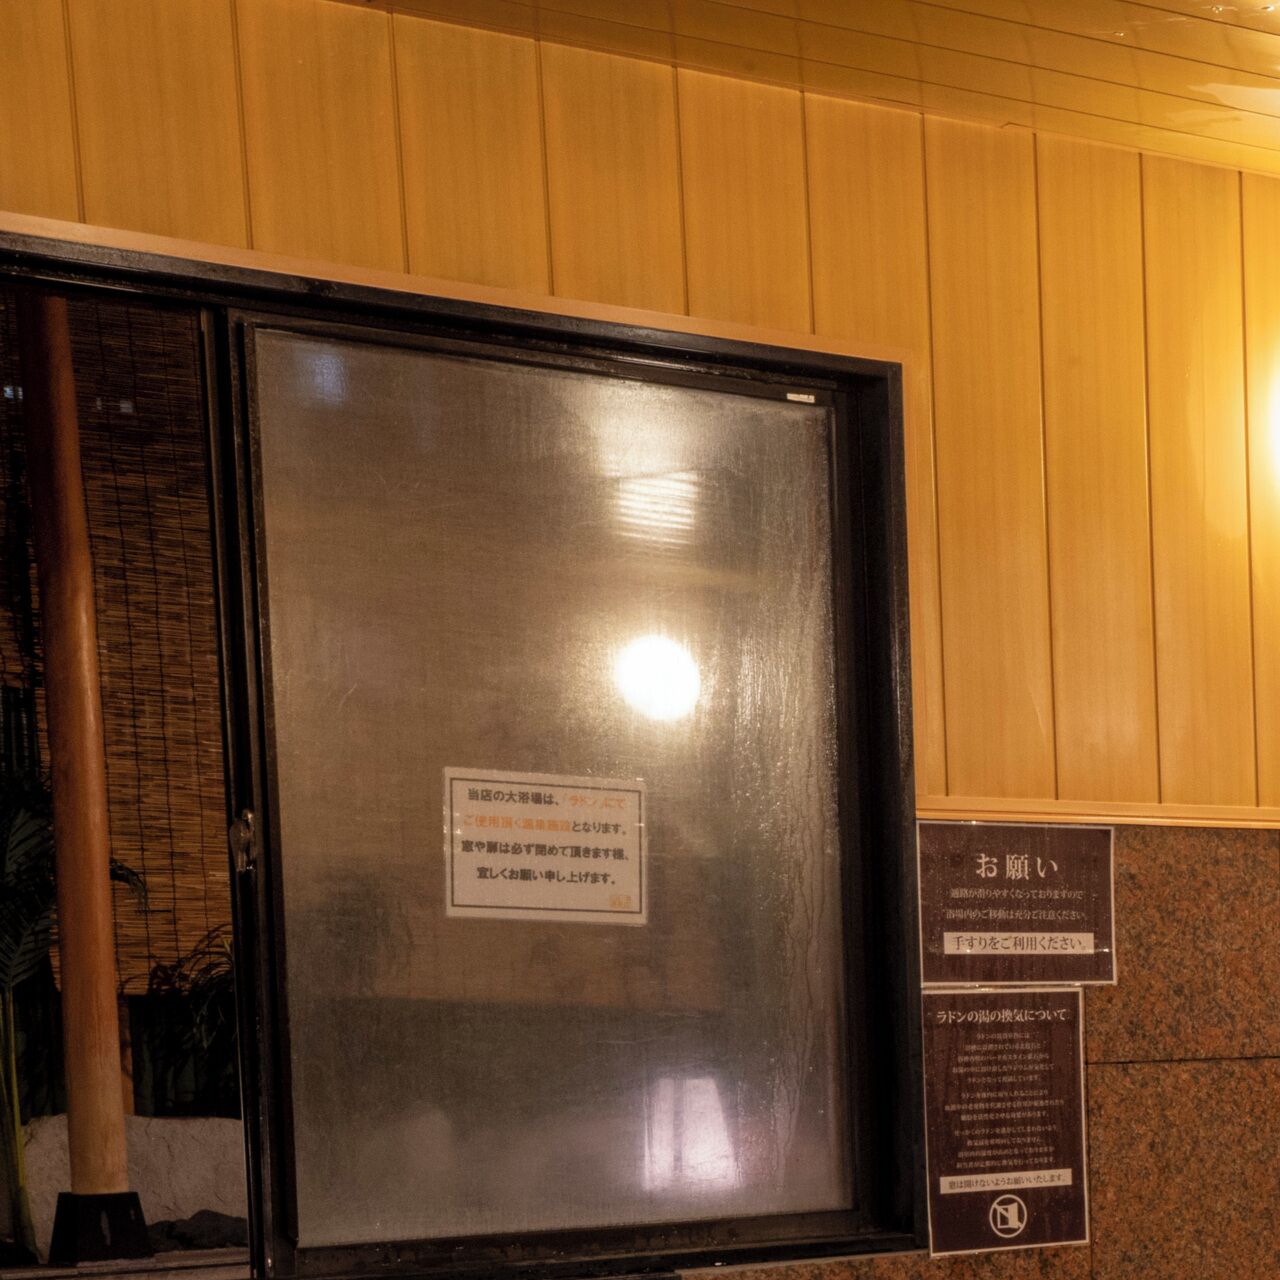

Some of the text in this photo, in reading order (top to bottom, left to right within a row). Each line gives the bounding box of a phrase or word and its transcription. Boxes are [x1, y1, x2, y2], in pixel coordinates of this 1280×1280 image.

[477, 866, 616, 885] 宜しくお願い申し上げます。
[975, 853, 1058, 880] お願い
[936, 1008, 1067, 1024] ラドンの湯の換気について
